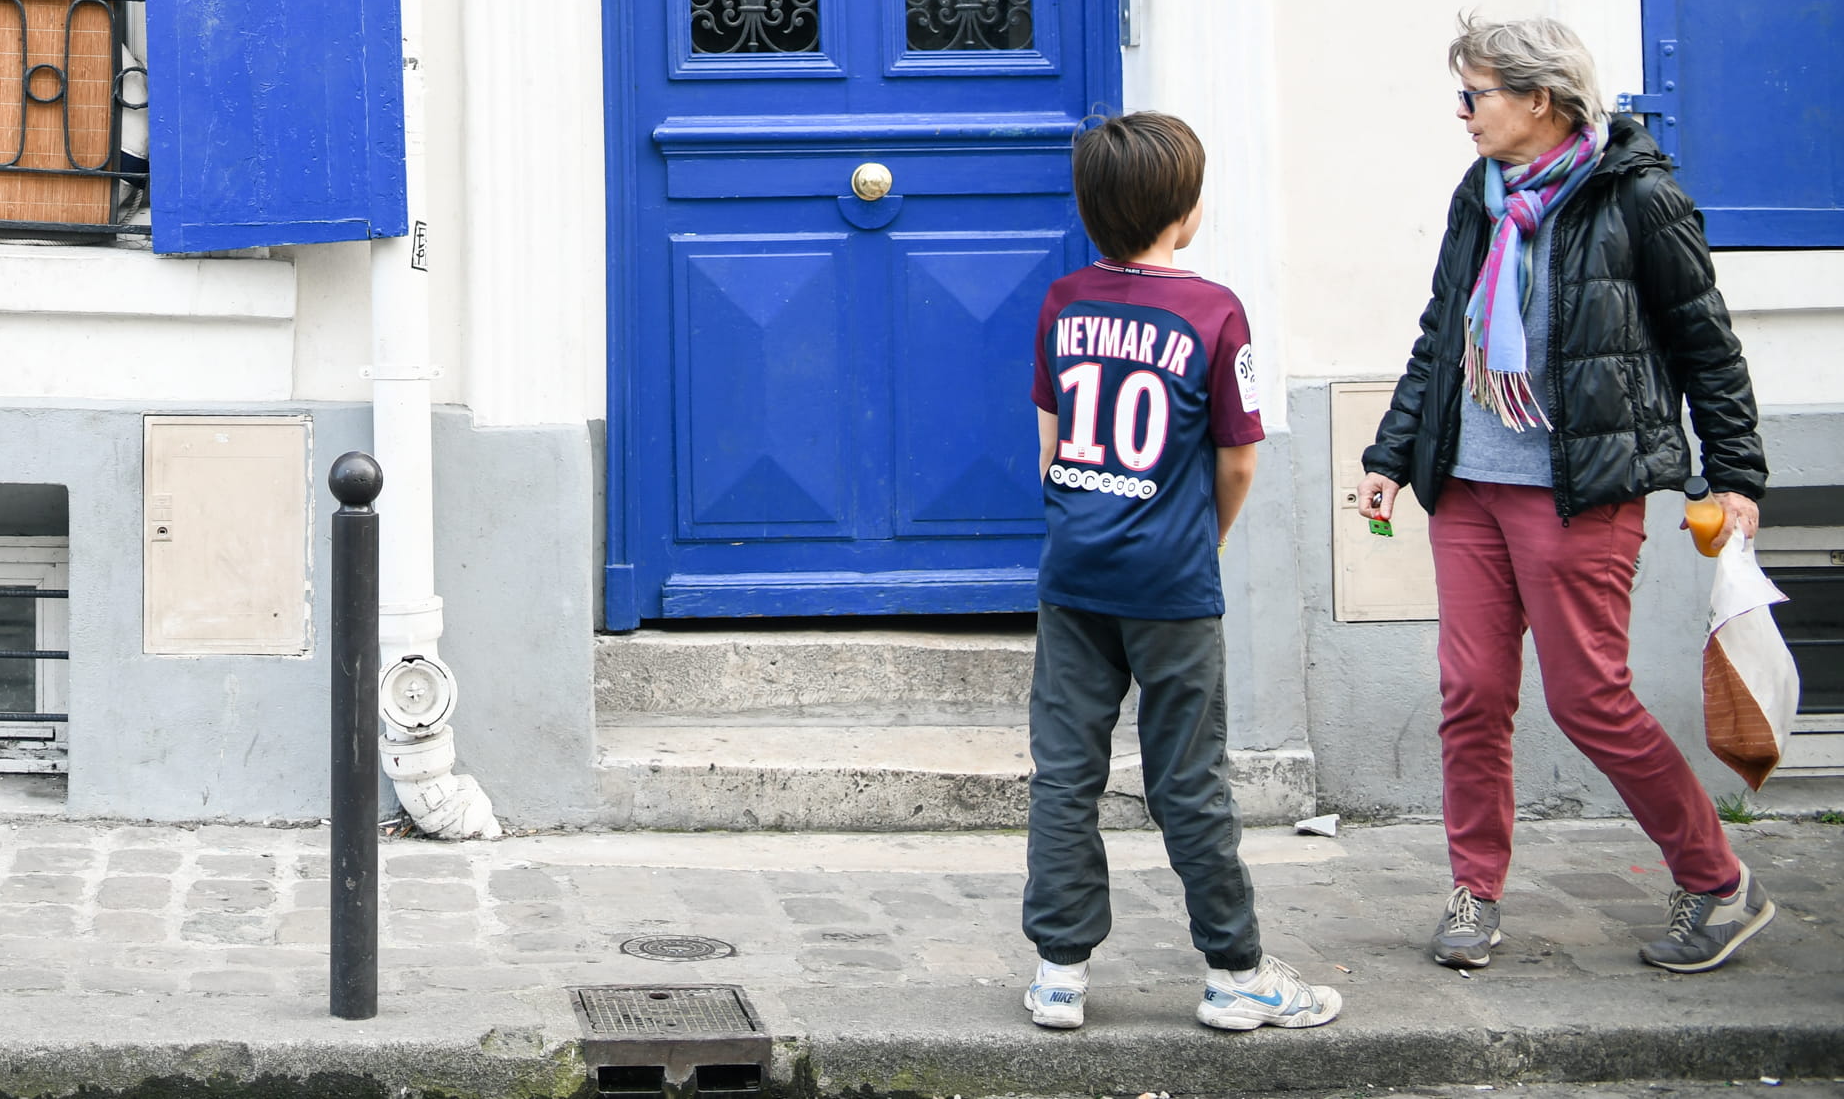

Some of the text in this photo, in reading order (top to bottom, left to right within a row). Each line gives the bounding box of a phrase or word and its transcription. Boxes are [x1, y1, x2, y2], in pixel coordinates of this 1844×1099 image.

[1056, 316, 1194, 377] NEYMAR JR
[1058, 361, 1169, 472] 10
[1052, 468, 1153, 496] ooredoo
[1049, 991, 1075, 1004] NIKE
